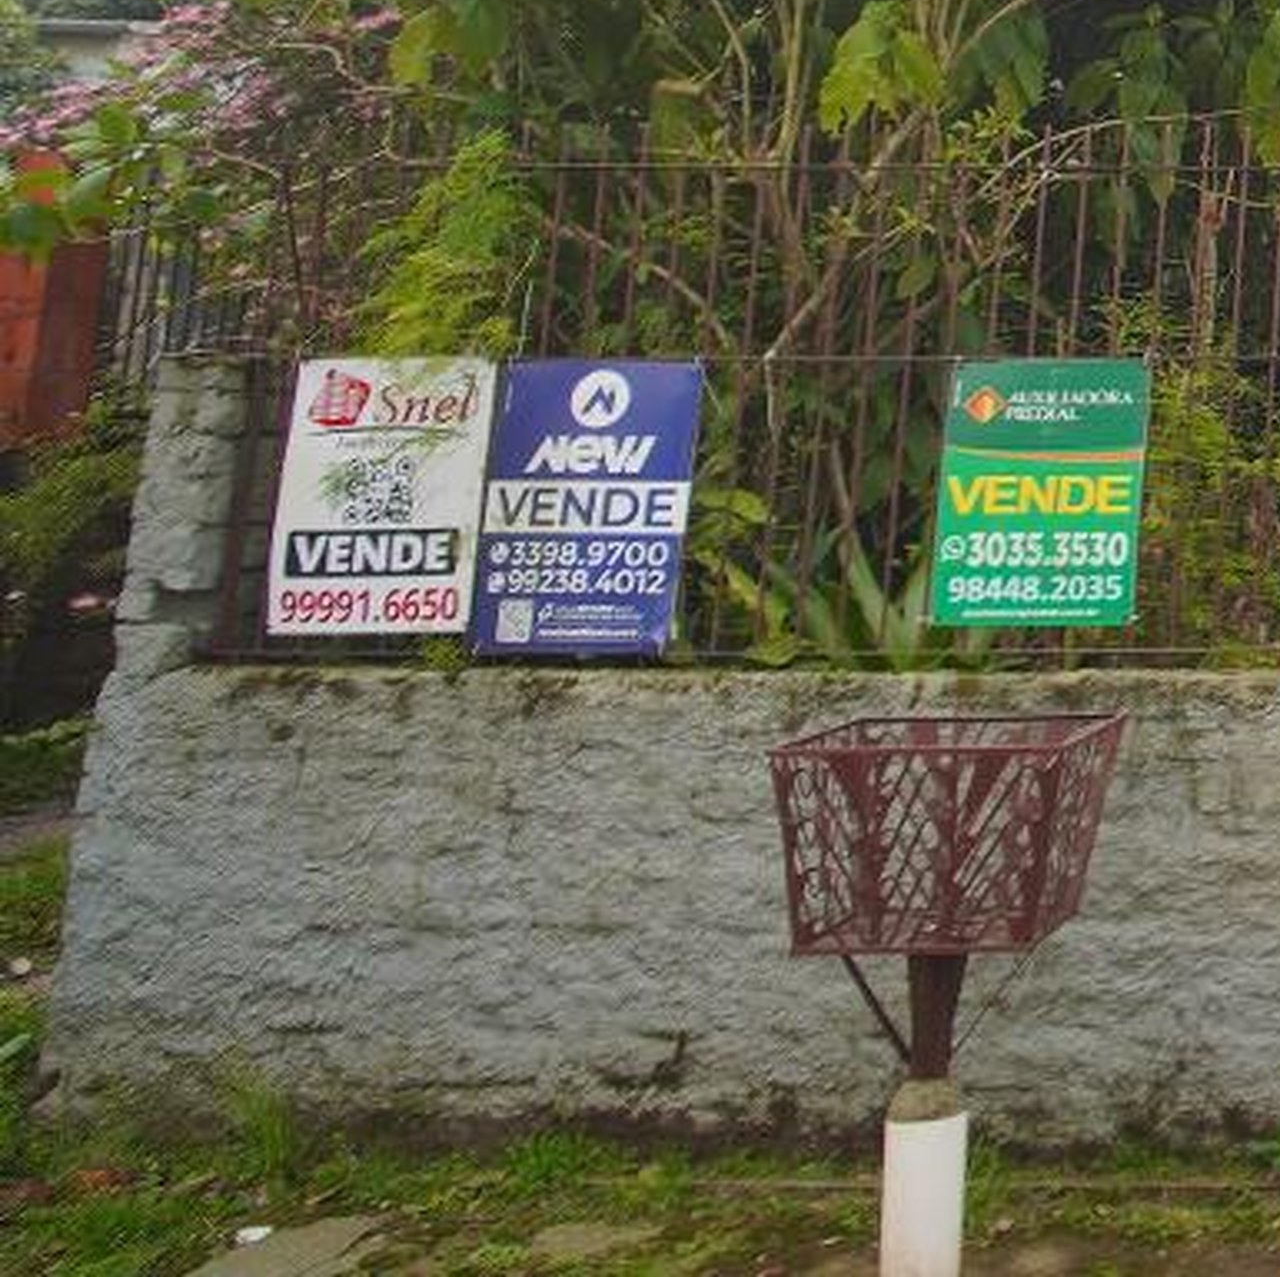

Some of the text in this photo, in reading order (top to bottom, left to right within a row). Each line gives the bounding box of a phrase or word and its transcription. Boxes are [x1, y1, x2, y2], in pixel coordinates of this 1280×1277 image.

[376, 372, 478, 424] Snel
[499, 488, 677, 527] VENDE
[947, 475, 1133, 514] VENDE
[296, 533, 451, 574] VENDE
[510, 540, 668, 566] 3398.9700
[966, 531, 1128, 566] 3035.3530
[508, 569, 665, 594] 99238.4012
[948, 575, 1123, 602] 98448.2035
[281, 588, 458, 624] 99991.6650
